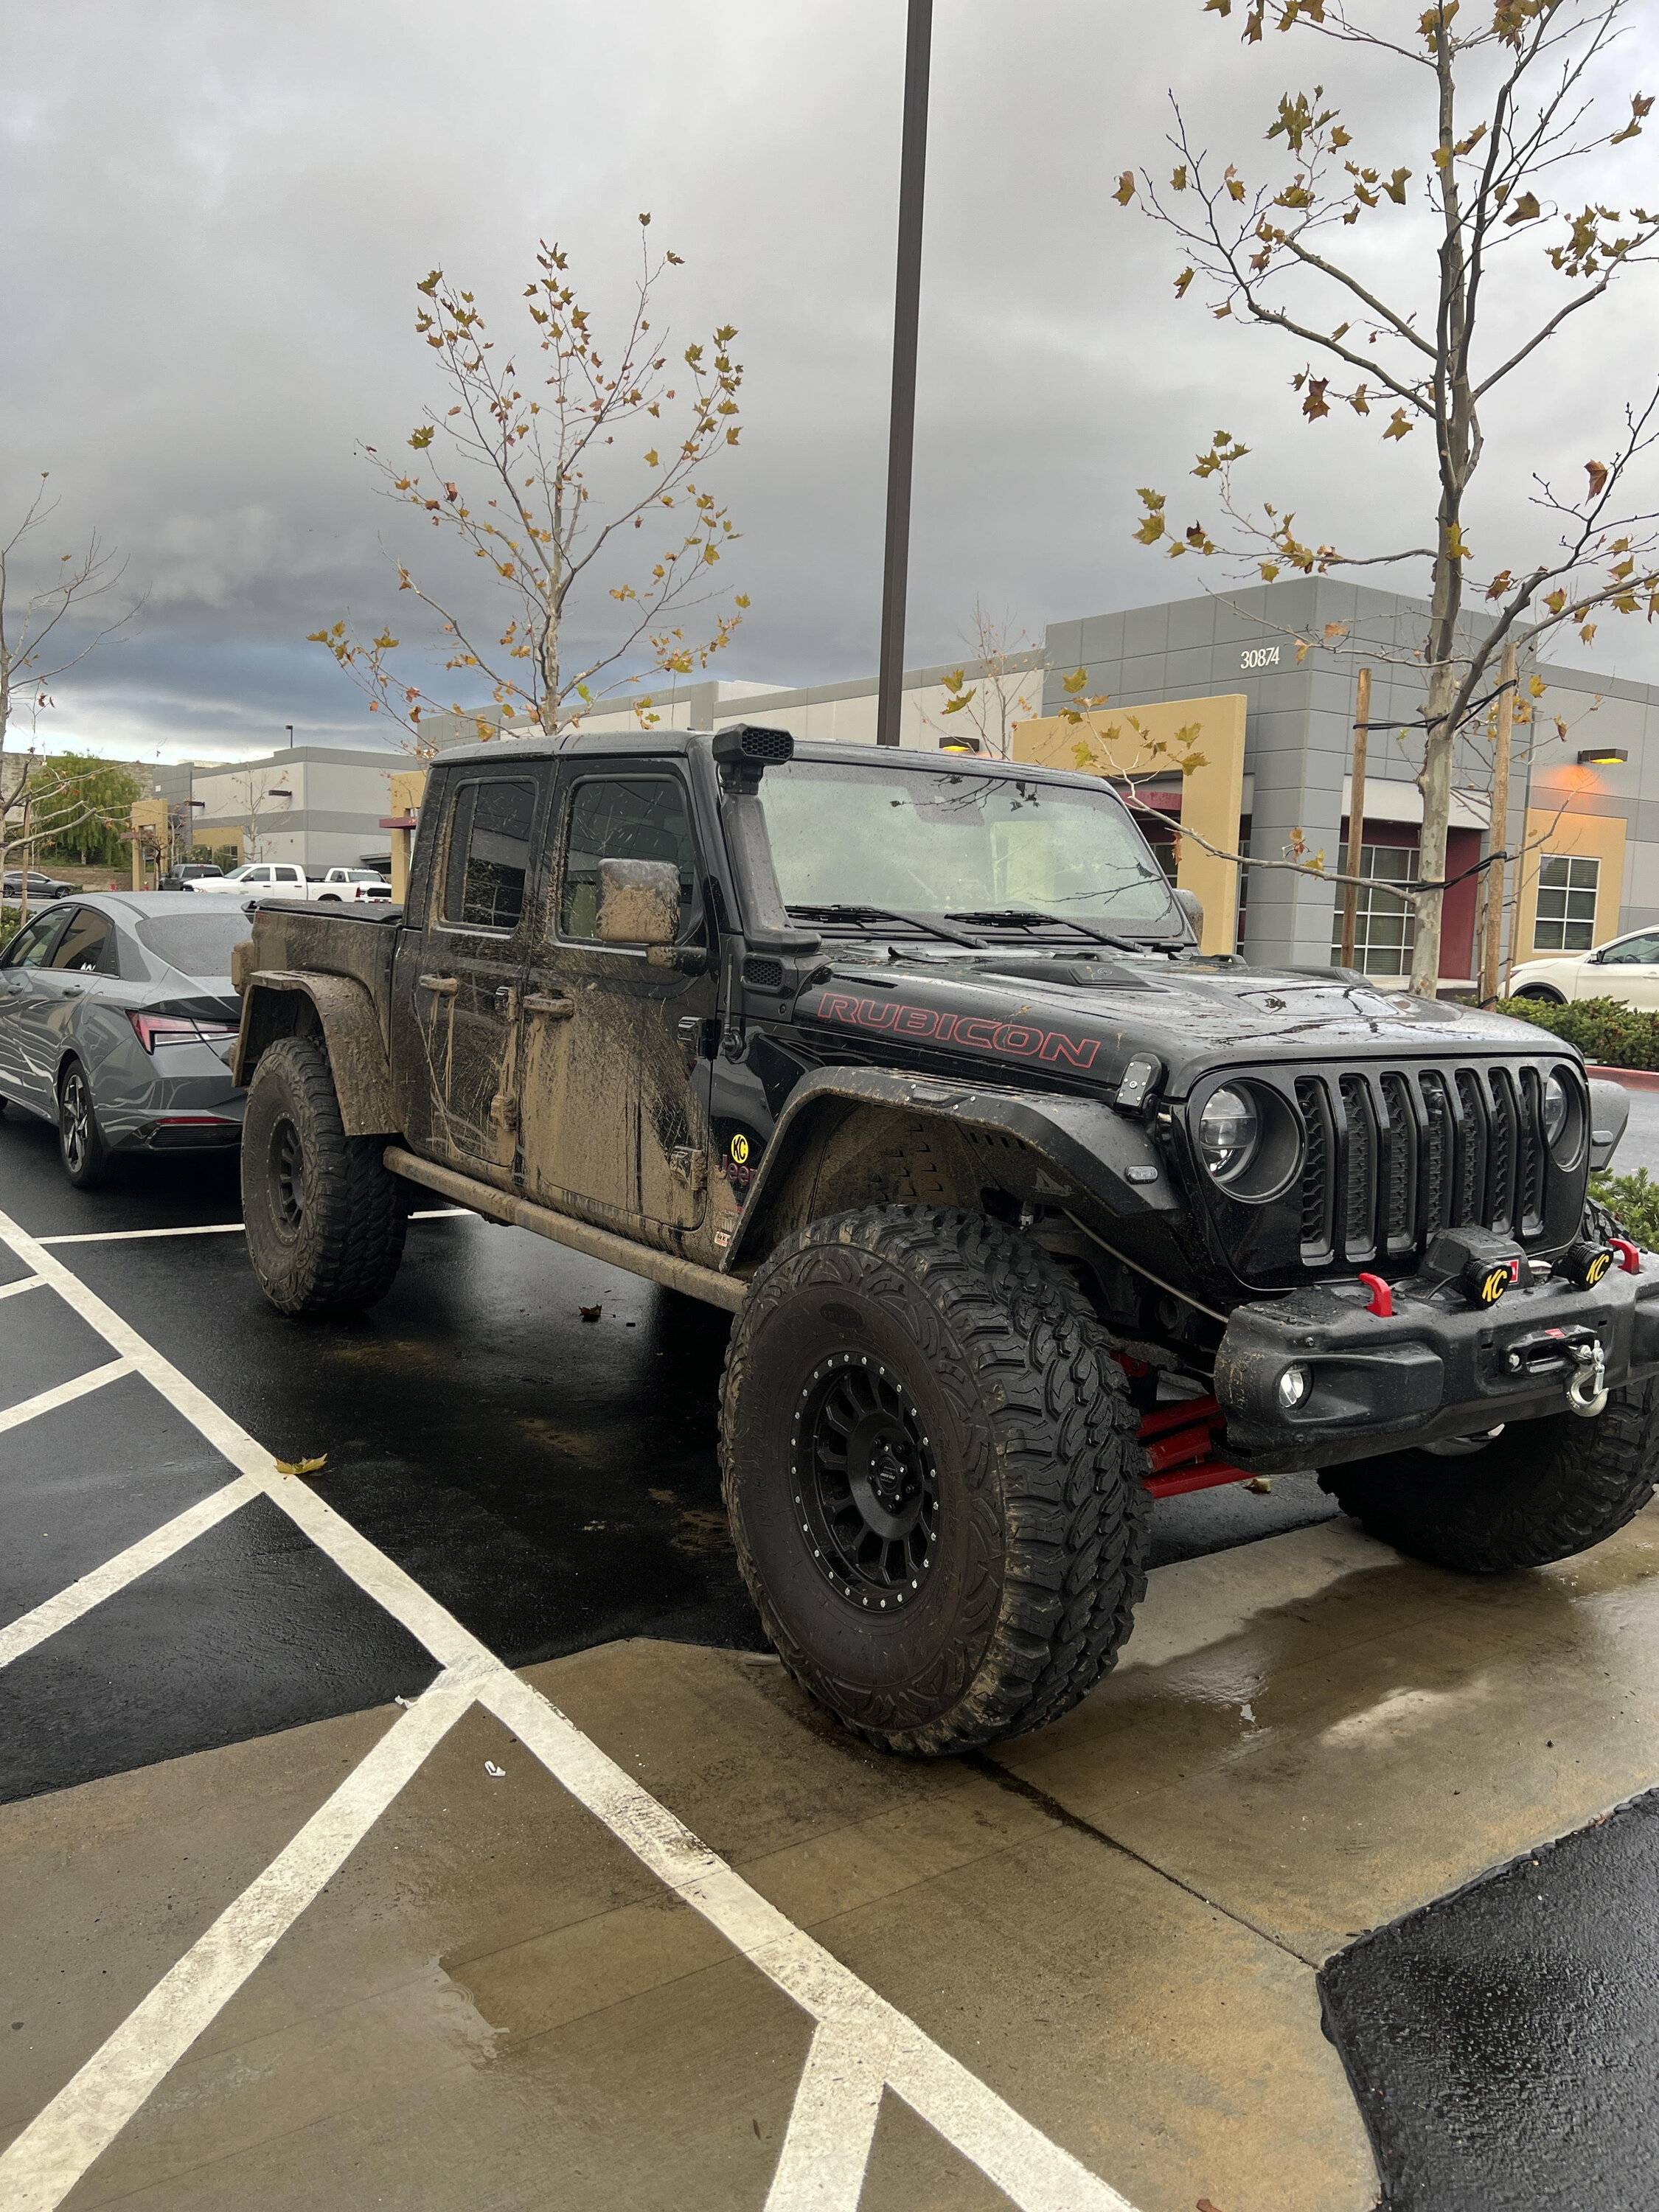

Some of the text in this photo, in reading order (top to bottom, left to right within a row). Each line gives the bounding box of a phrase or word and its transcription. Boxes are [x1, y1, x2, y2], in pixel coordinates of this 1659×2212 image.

[1240, 646, 1280, 669] 30874
[818, 992, 1102, 1068] RUBICON
[732, 1135, 747, 1162] KC
[1586, 1253, 1610, 1284] KC
[1482, 1269, 1508, 1302] KC
